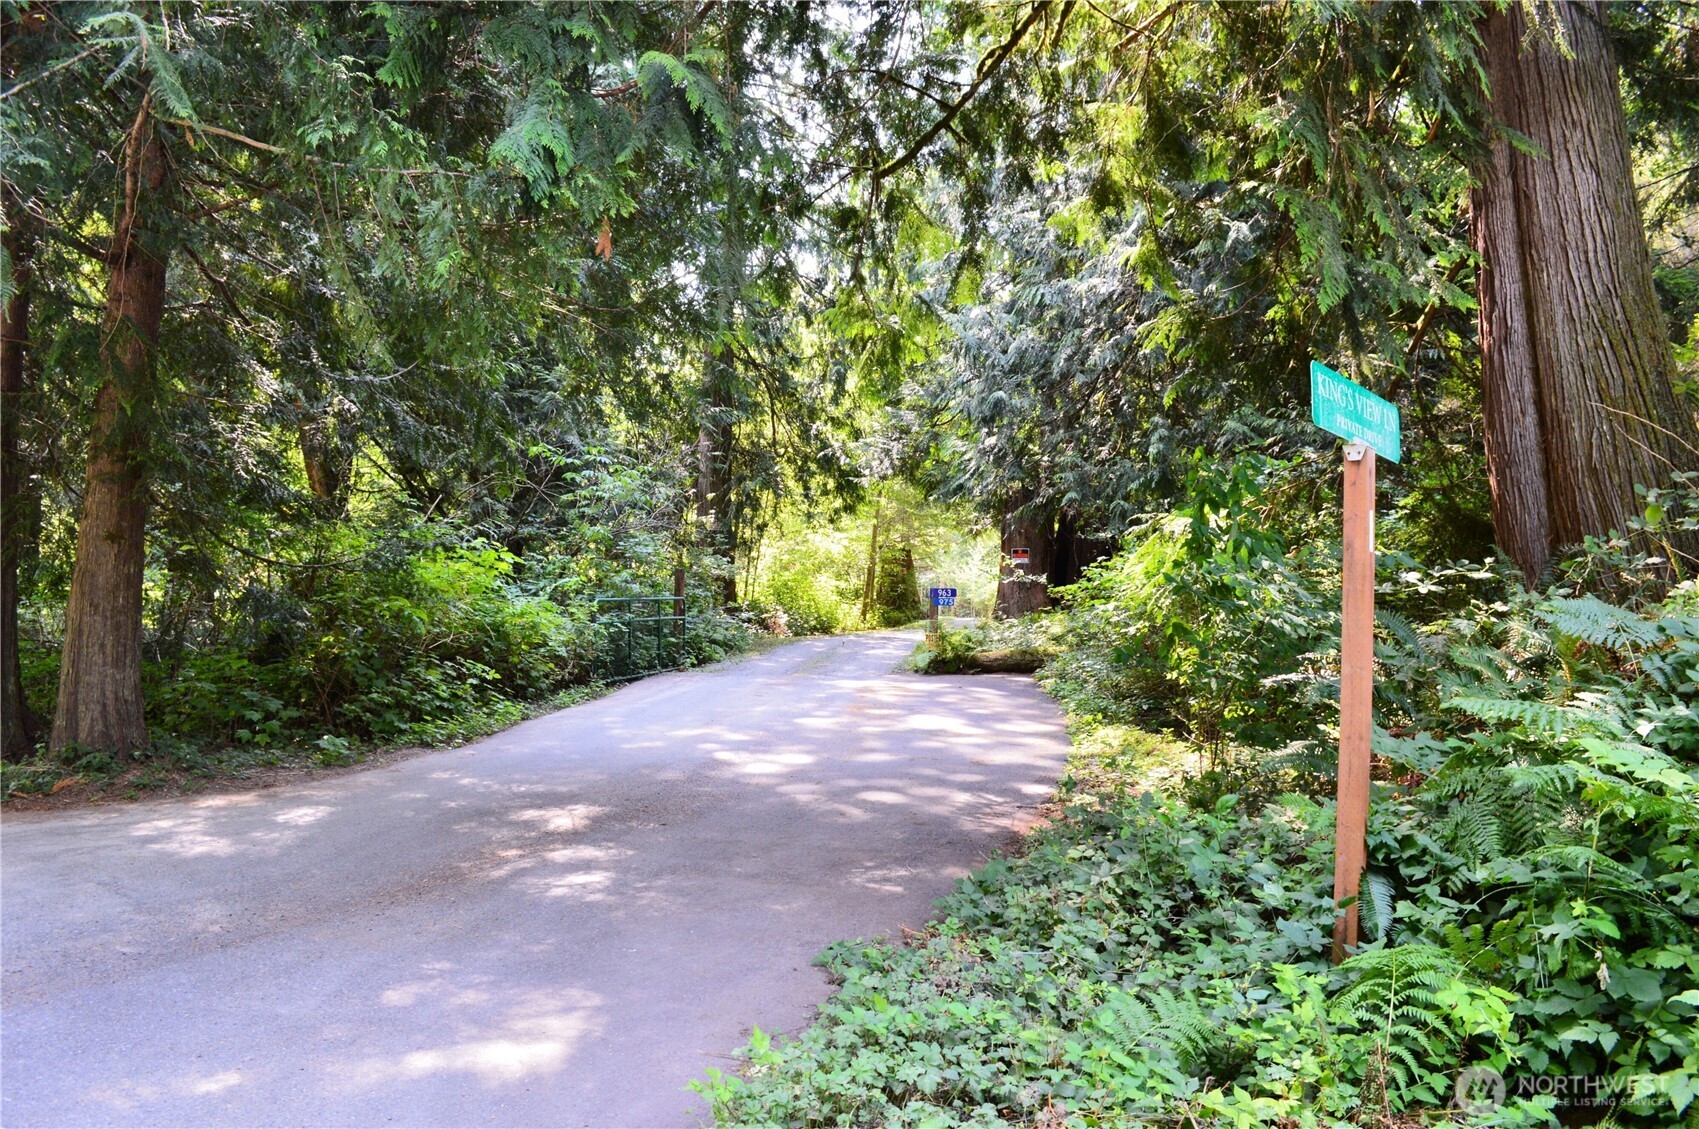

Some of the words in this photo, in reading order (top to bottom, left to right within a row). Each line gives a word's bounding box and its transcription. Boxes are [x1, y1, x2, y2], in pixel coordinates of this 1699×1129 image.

[1317, 372, 1354, 411] KING'S
[1355, 393, 1381, 424] VIEW
[1384, 409, 1396, 432] LN
[1336, 413, 1363, 437] PRIVATE
[1364, 427, 1382, 447] DRIVE
[937, 589, 952, 597] 963
[938, 598, 954, 606] 975
